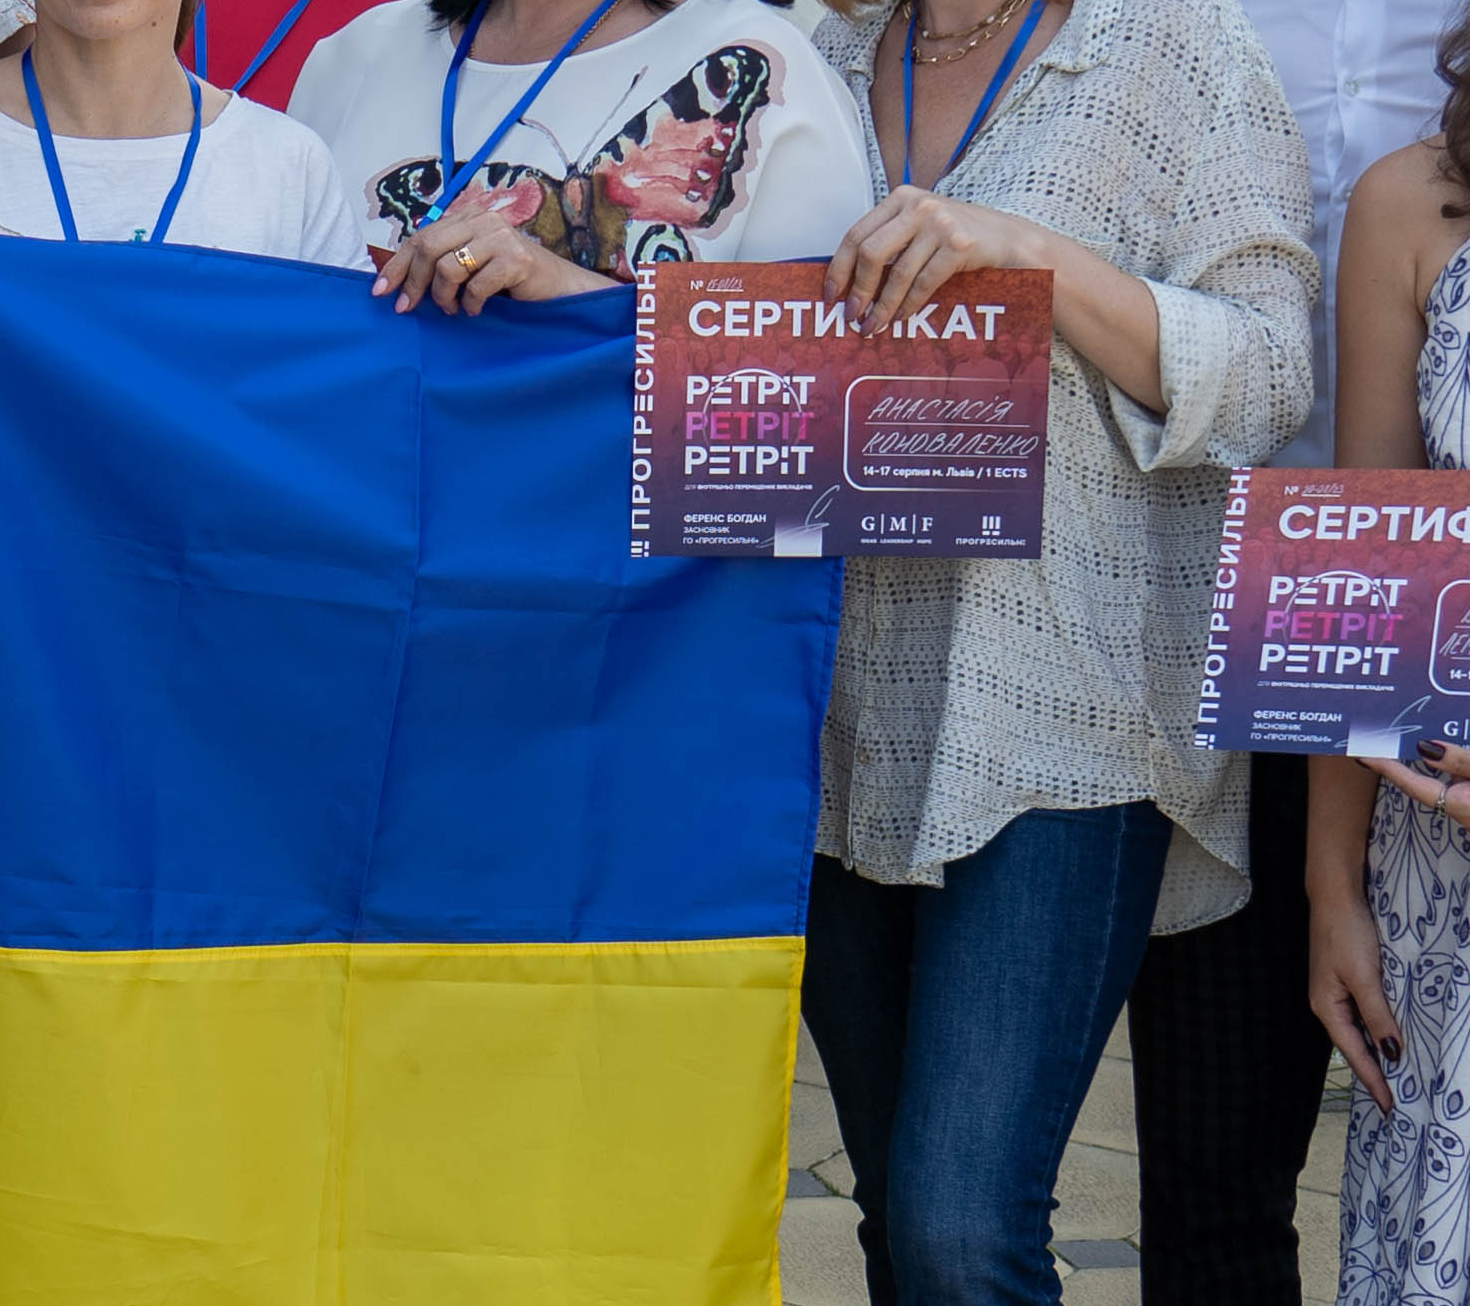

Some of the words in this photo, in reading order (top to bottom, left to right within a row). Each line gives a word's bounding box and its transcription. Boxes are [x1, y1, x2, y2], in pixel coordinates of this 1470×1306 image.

[688, 299, 1006, 341] СЕРТИІКАТ
[862, 431, 1039, 456] КОНОВАЛЕНКО
[946, 467, 975, 477] Львів
[995, 468, 1027, 478] ECTS
[683, 514, 724, 523] ФЕРЕНС
[727, 514, 767, 523] БОГДАН
[1253, 710, 1297, 721] ФЕРЕНС
[1299, 712, 1342, 723] БОГДАН
